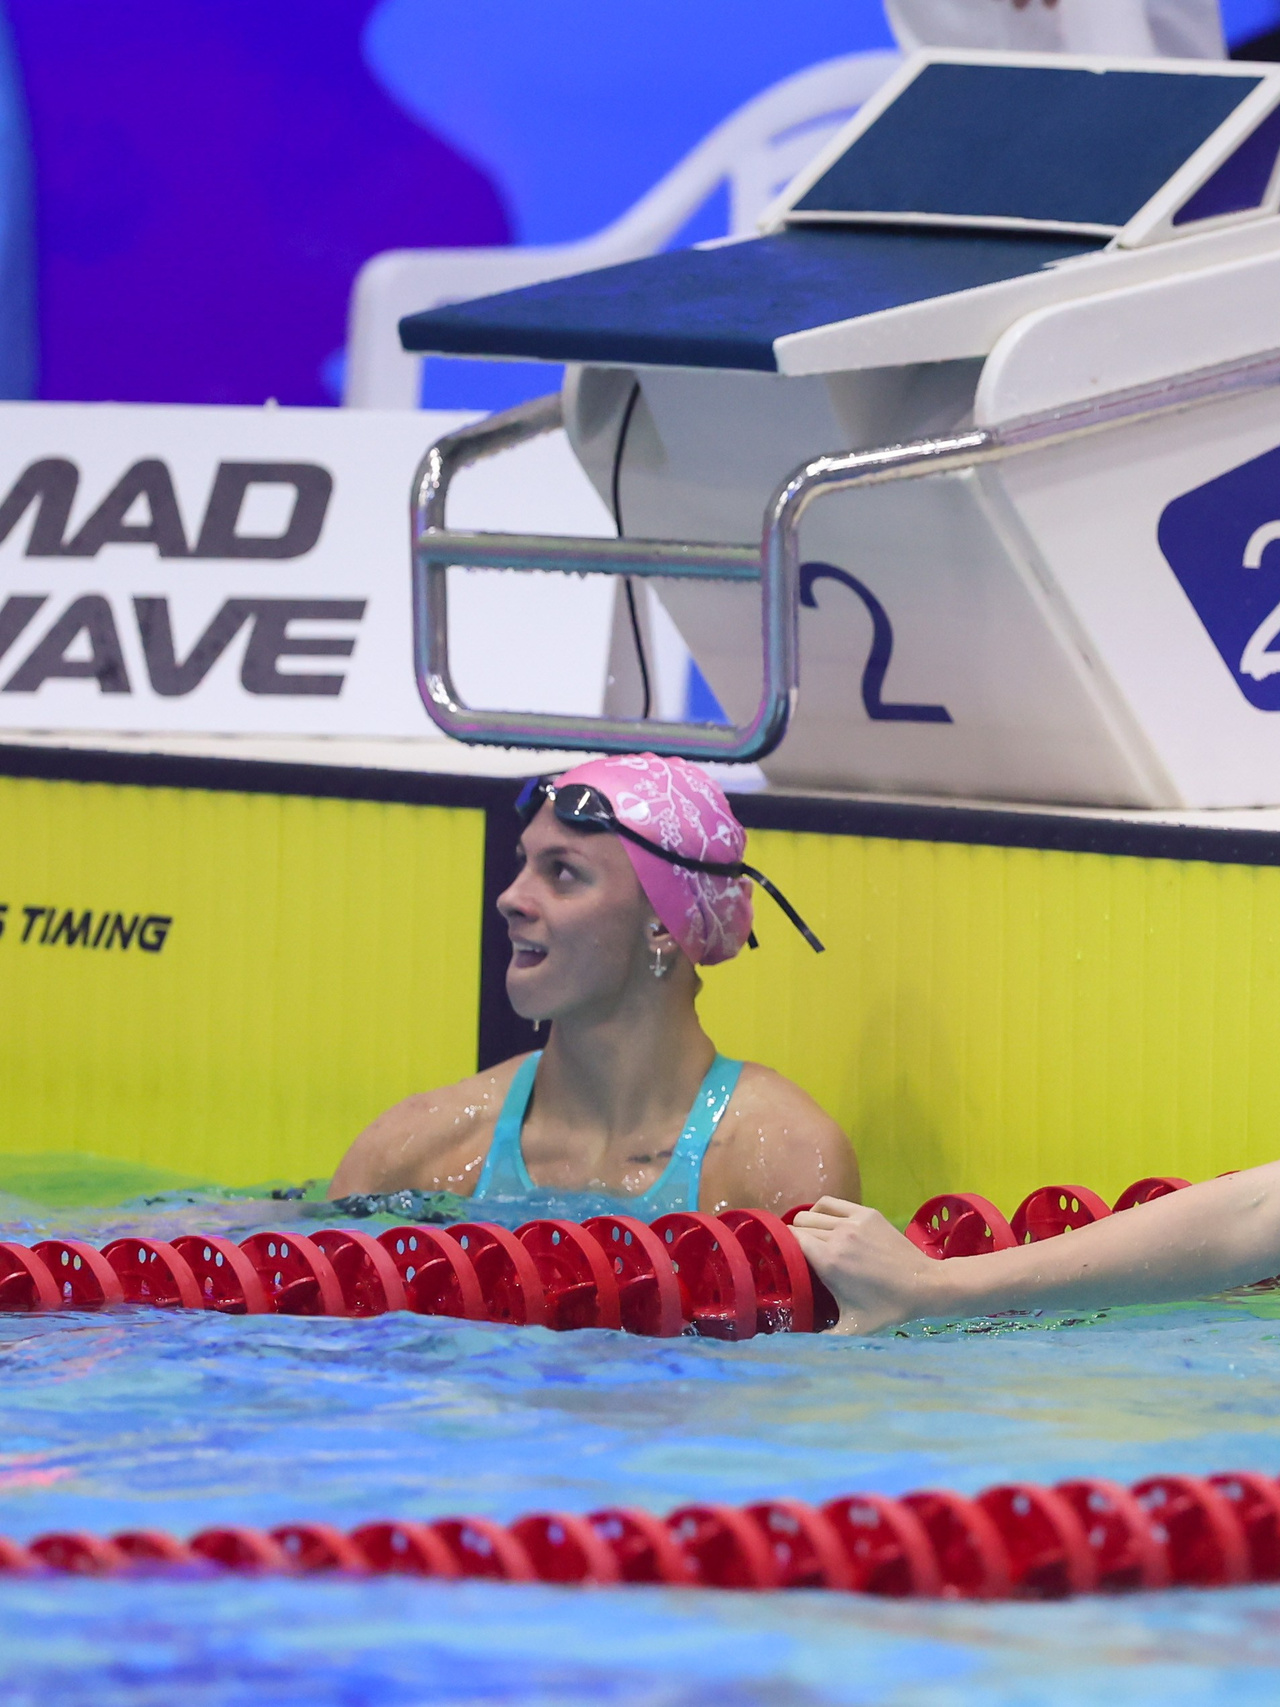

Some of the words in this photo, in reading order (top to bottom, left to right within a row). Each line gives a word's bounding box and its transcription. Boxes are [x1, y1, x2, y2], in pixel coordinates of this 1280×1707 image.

[0, 594, 368, 697] AVE
[799, 561, 954, 724] 2
[22, 904, 173, 954] TIMING
